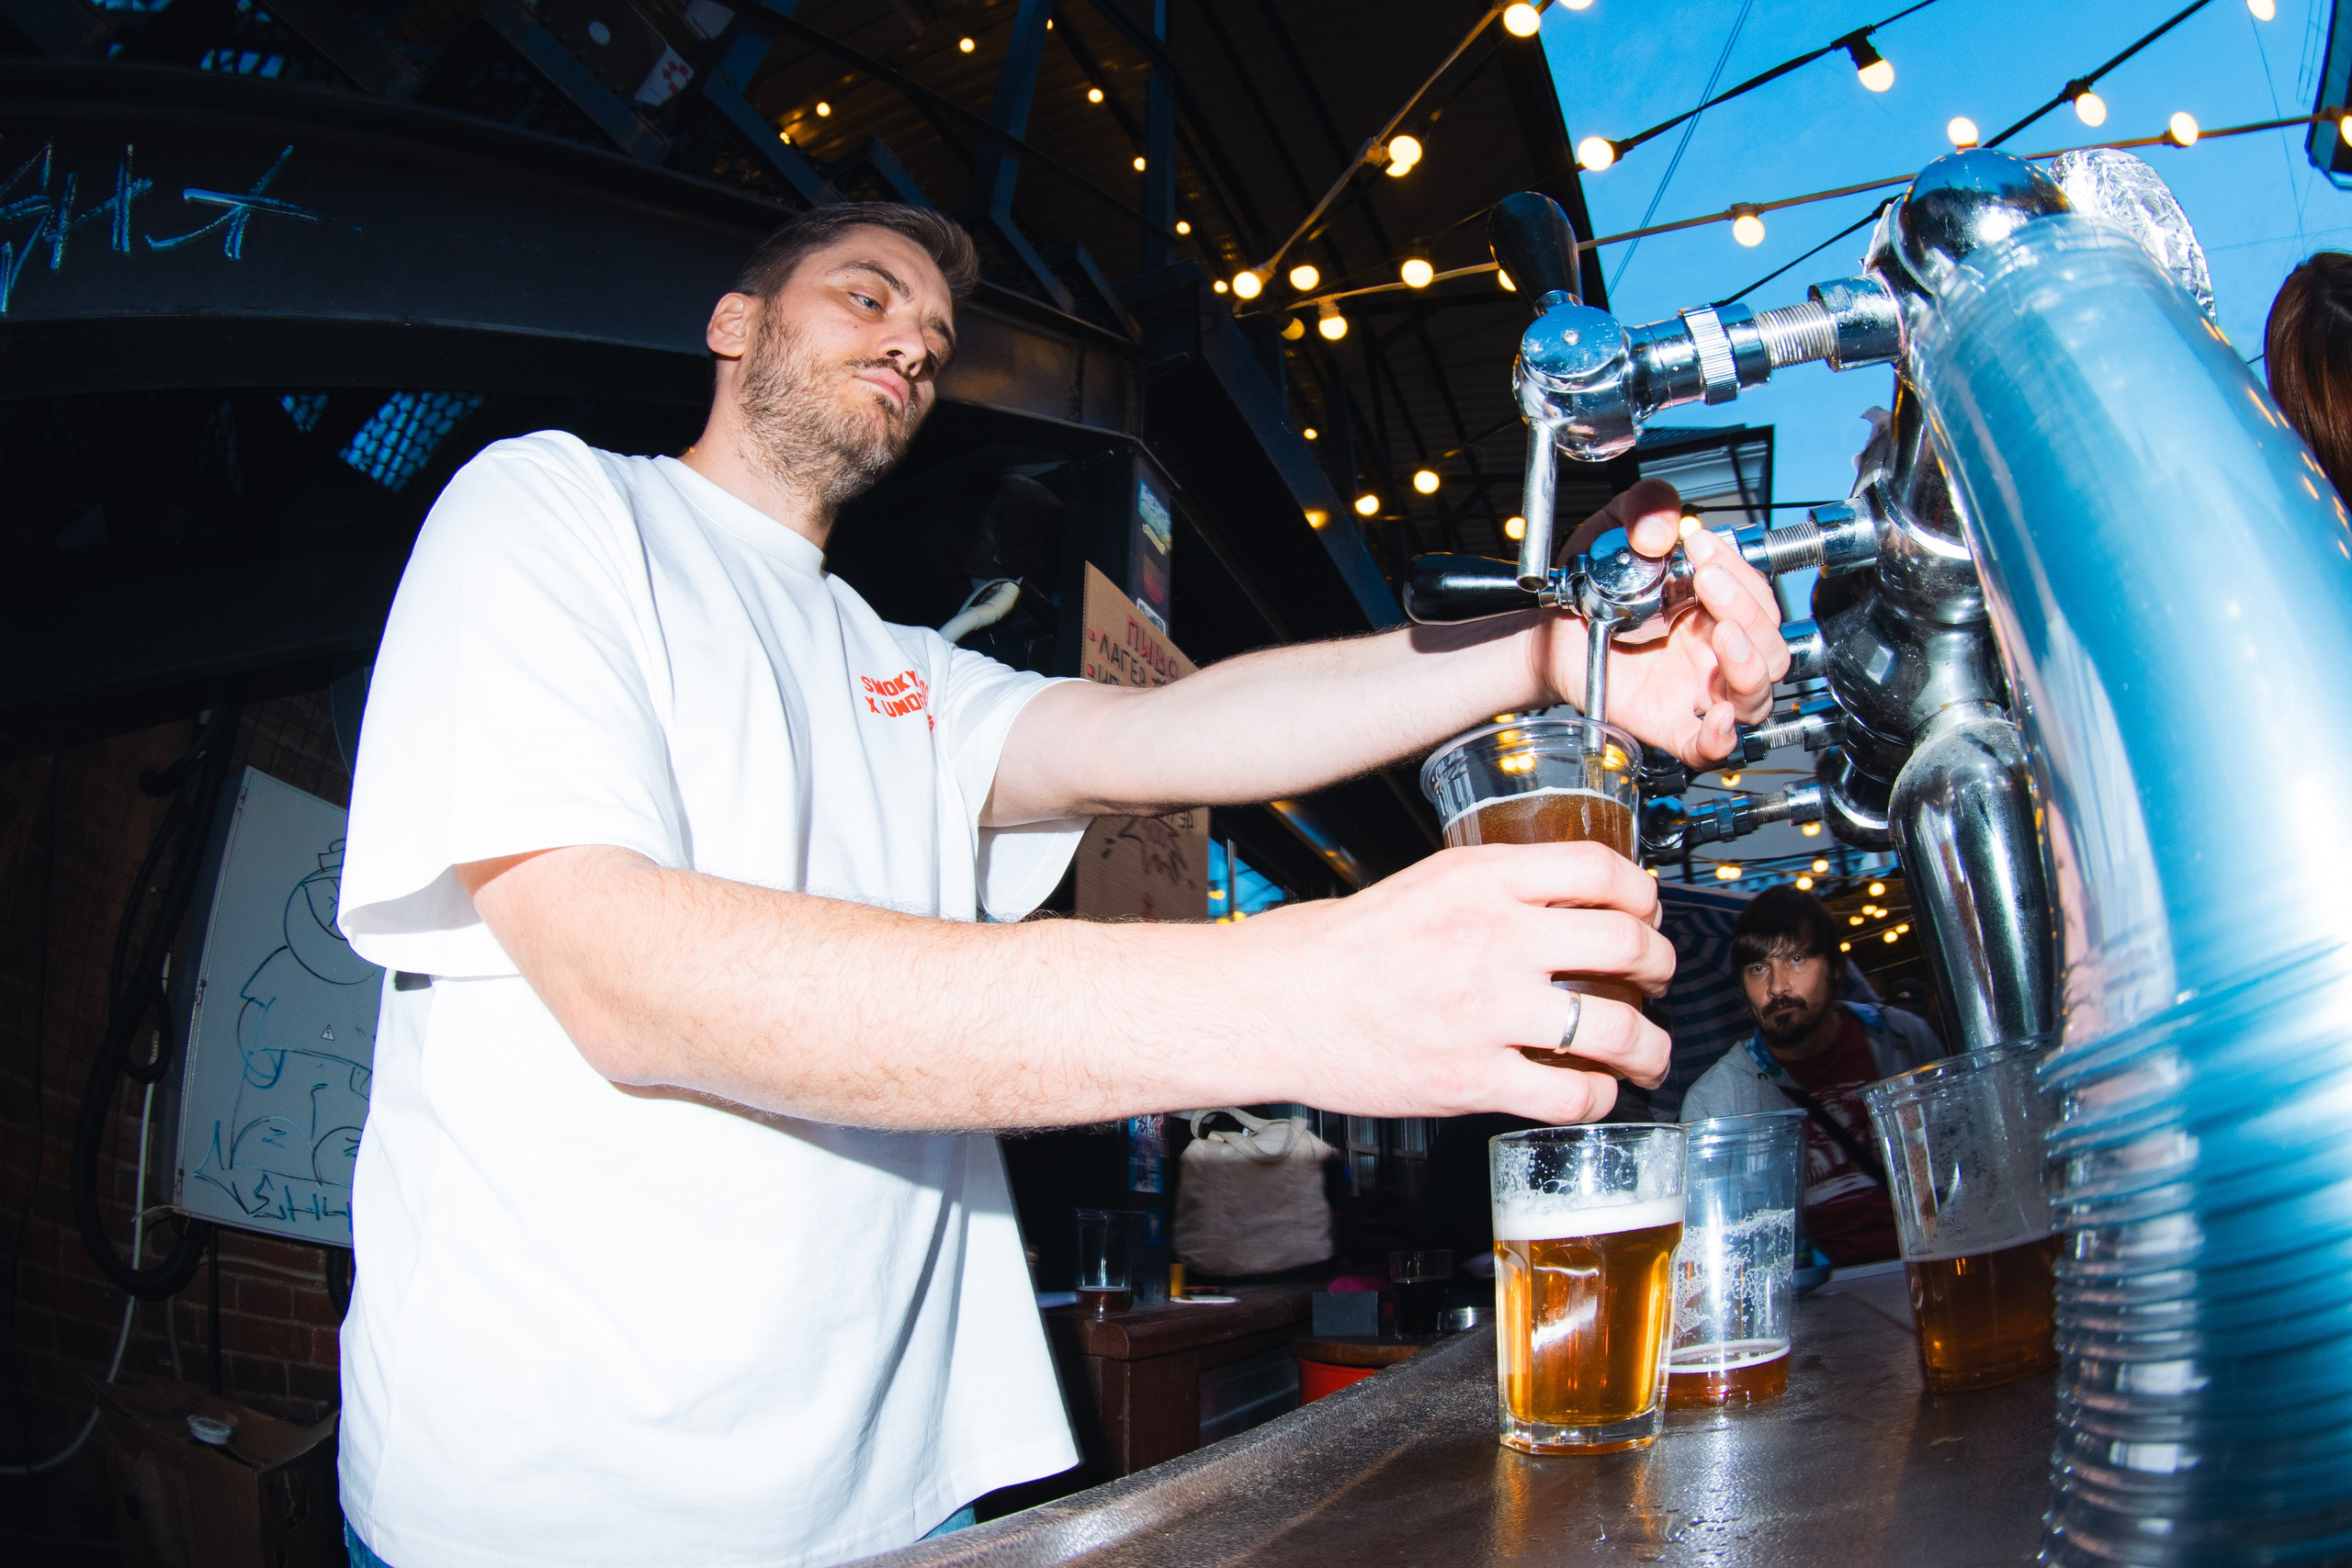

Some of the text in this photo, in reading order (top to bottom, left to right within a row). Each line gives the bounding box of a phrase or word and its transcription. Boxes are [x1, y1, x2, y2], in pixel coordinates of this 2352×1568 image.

[1126, 614, 1178, 681] ПИВО
[861, 671, 919, 696] SMOKY
[865, 696, 880, 714] X
